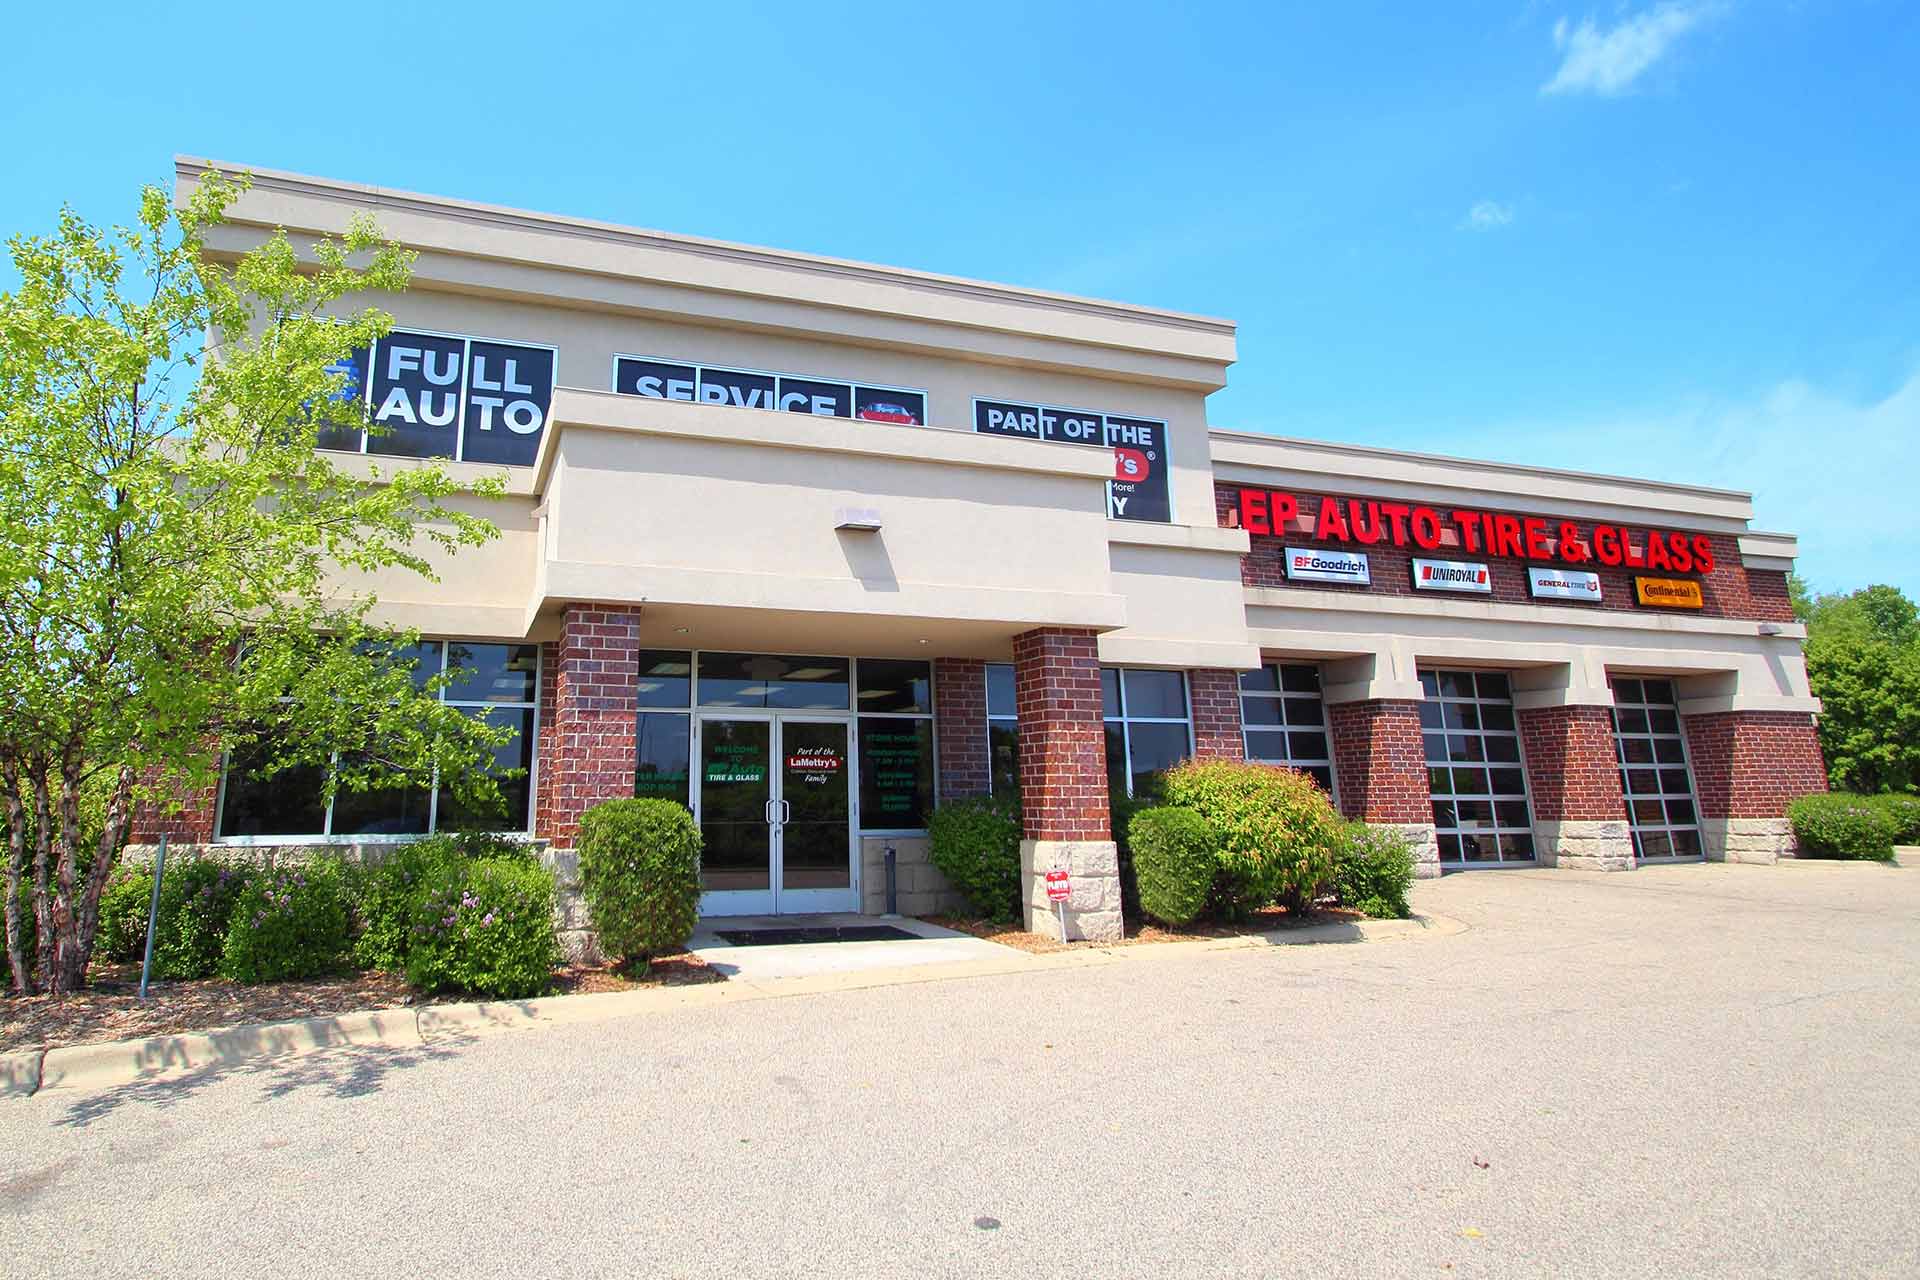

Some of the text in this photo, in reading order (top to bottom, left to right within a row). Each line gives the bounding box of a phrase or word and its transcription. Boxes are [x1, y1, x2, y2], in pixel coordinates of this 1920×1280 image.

[388, 345, 532, 394] FULL
[375, 387, 543, 434] AUTO
[988, 408, 1153, 446] PART OF THE
[1238, 488, 1715, 575] EP AUTO TIRE & GLASS
[1294, 556, 1366, 572] BFGoodrich
[1432, 567, 1477, 583] UNIROYAL
[814, 747, 823, 755] of
[804, 774, 828, 784] Family
